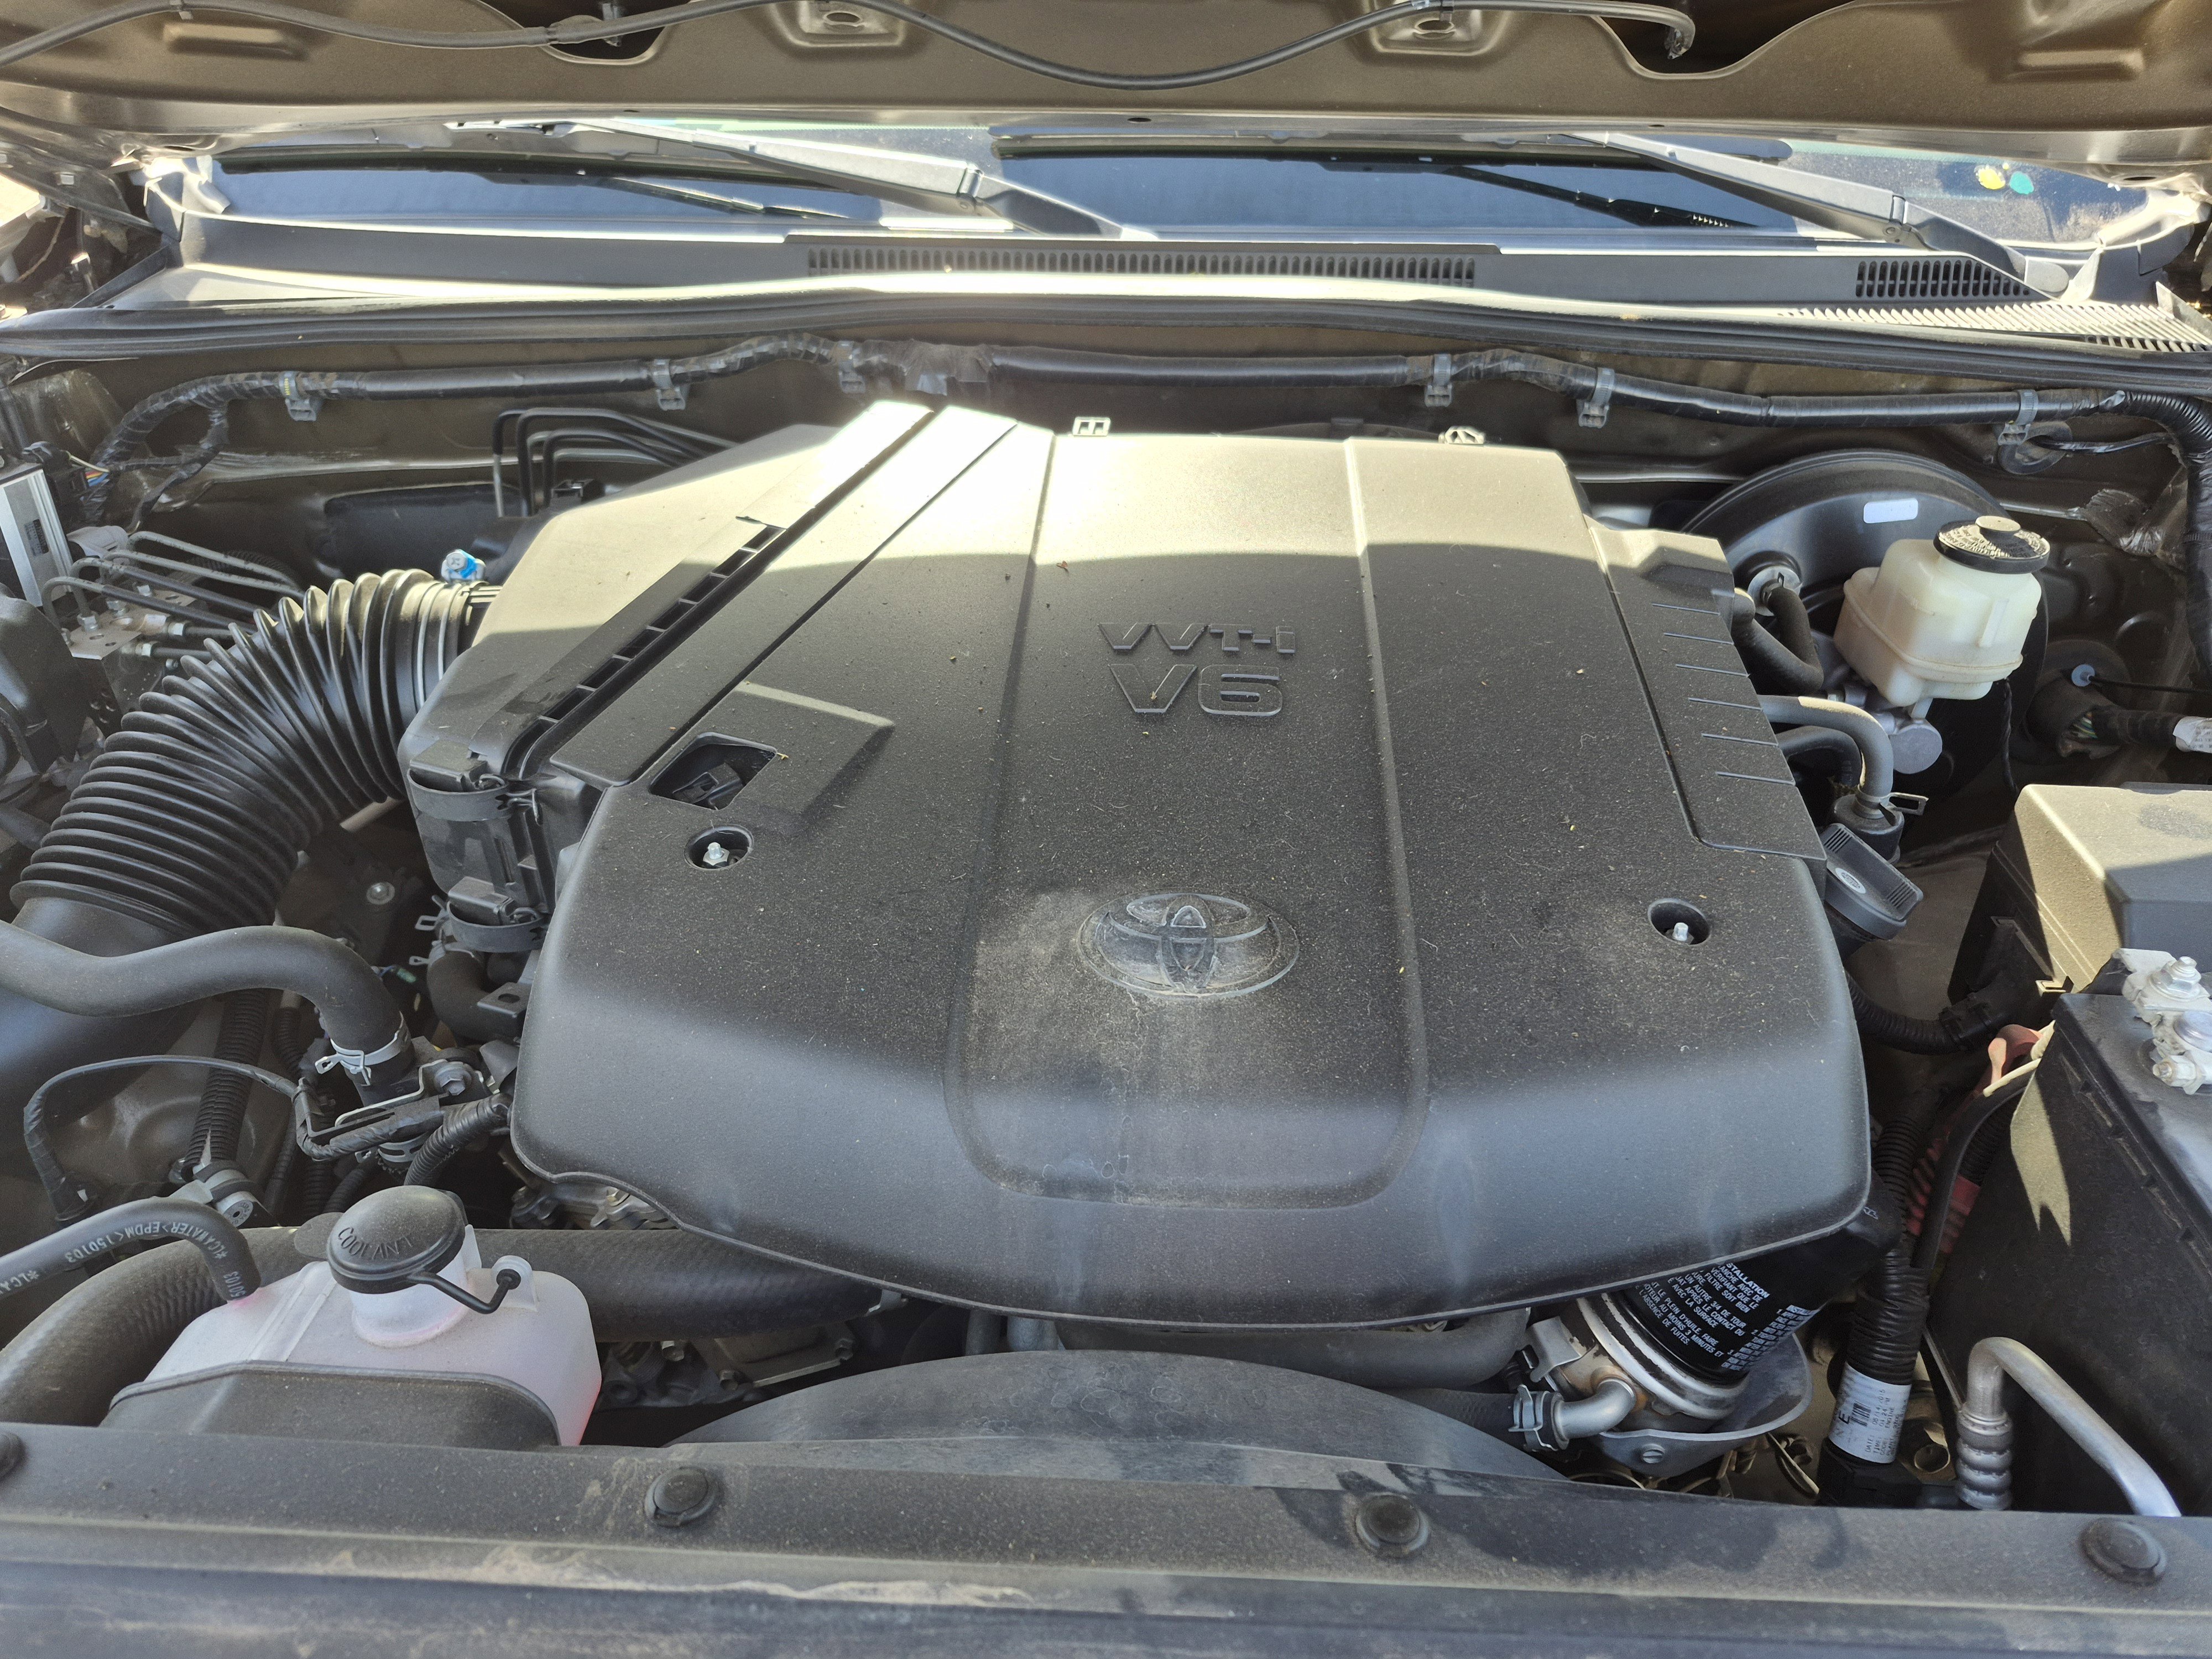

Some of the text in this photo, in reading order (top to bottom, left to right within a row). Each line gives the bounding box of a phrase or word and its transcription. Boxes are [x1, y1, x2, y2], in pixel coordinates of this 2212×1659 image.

[1108, 663, 1283, 716] V6
[338, 1227, 414, 1260] COOLANT
[1704, 1272, 1750, 1313] FILTRE SOIT BIEN
[1718, 1266, 1763, 1303] ANCHE AVEC DE
[1726, 1262, 1770, 1298] STALLATION
[1736, 1292, 1750, 1303] QUE
[1639, 1289, 1663, 1319] L'ABSENCE
[1662, 1318, 1672, 1327] DE
[1643, 1283, 1661, 1303] OTEUR
[1658, 1303, 1669, 1313] AU
[1667, 1312, 1686, 1331] MOINS
[1691, 1334, 1716, 1353] MINUTES
[1657, 1288, 1666, 1298] LE
[1664, 1297, 1681, 1314] PLEIN
[1701, 1333, 1719, 1347] FAIRE
[1672, 1284, 1687, 1298] AVEC
[1684, 1297, 1694, 1307] LA
[1693, 1306, 1719, 1328] SURFACE
[1684, 1274, 1746, 1329] UN AUTRE 3/4 DE TOUR
[1702, 1303, 1712, 1312] LE
[1710, 1311, 1736, 1330] CONTACT
